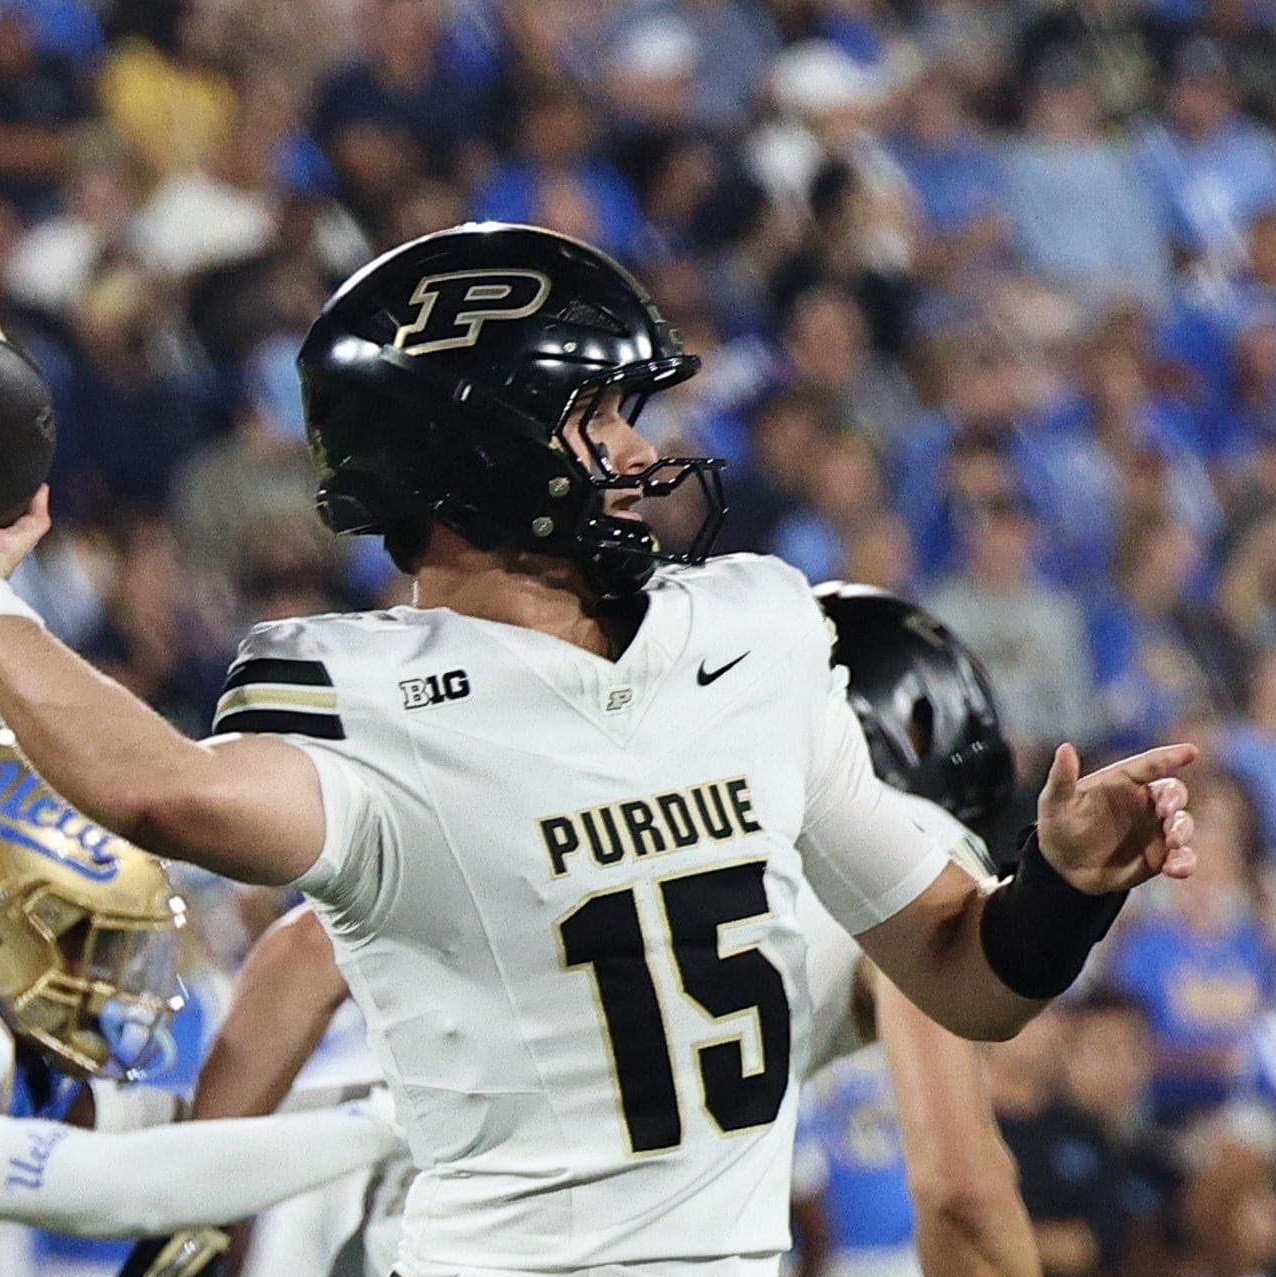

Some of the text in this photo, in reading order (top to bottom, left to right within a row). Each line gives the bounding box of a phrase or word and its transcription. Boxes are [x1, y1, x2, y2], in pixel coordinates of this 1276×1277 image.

[393, 268, 552, 357] P
[605, 688, 633, 711] P
[535, 774, 763, 879] PURDUE
[551, 854, 792, 1159] 15
